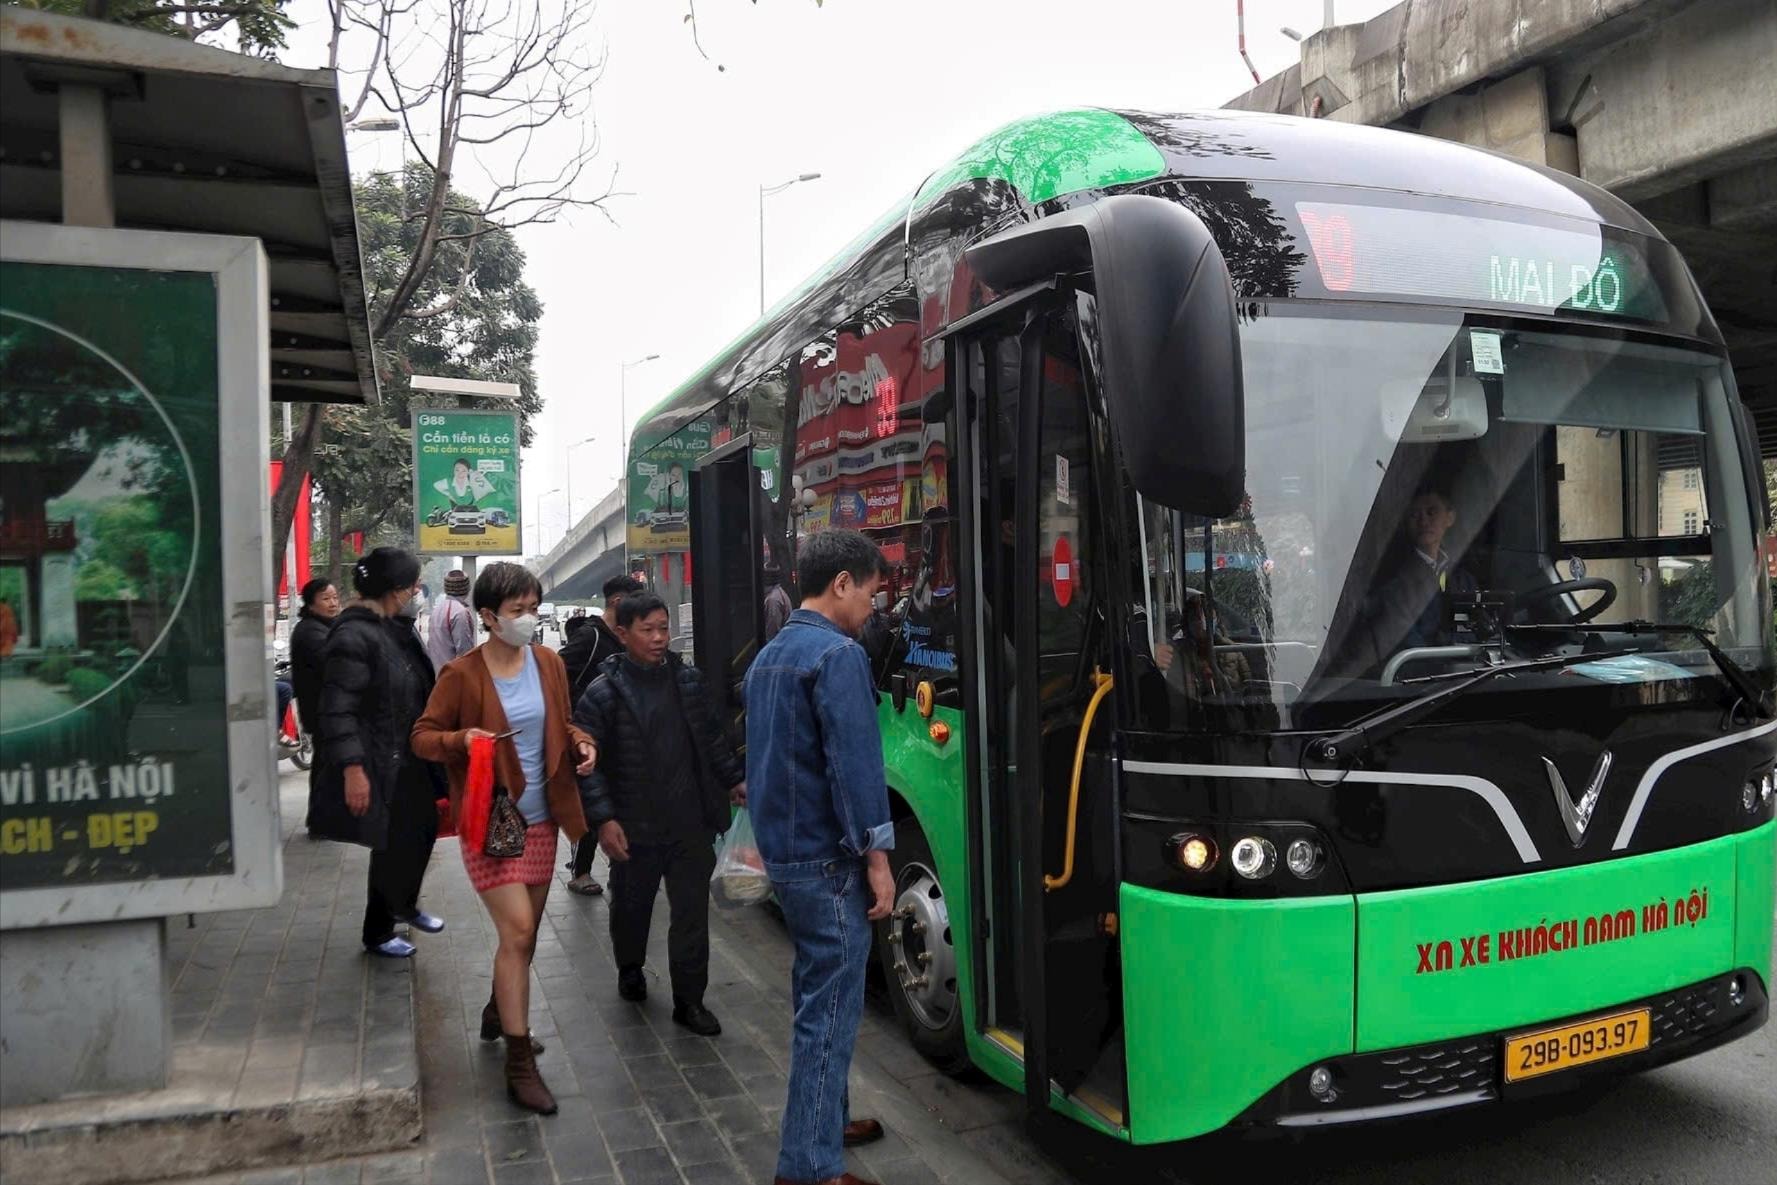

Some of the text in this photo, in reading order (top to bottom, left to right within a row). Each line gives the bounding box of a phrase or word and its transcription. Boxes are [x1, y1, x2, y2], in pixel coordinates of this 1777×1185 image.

[1490, 255, 1621, 312] MAI ĐÔ
[422, 430, 511, 444] Cần tiền là có
[441, 444, 459, 453] cần
[486, 446, 497, 456] ký
[0, 756, 174, 806] VÌ HÀ NỘI
[0, 816, 53, 855] CH
[86, 810, 160, 855] ĐẸP
[1416, 887, 1708, 974] XN XE KHÁCH NAM HÀ NỘI
[1520, 1020, 1638, 1071] 29B-093.97
